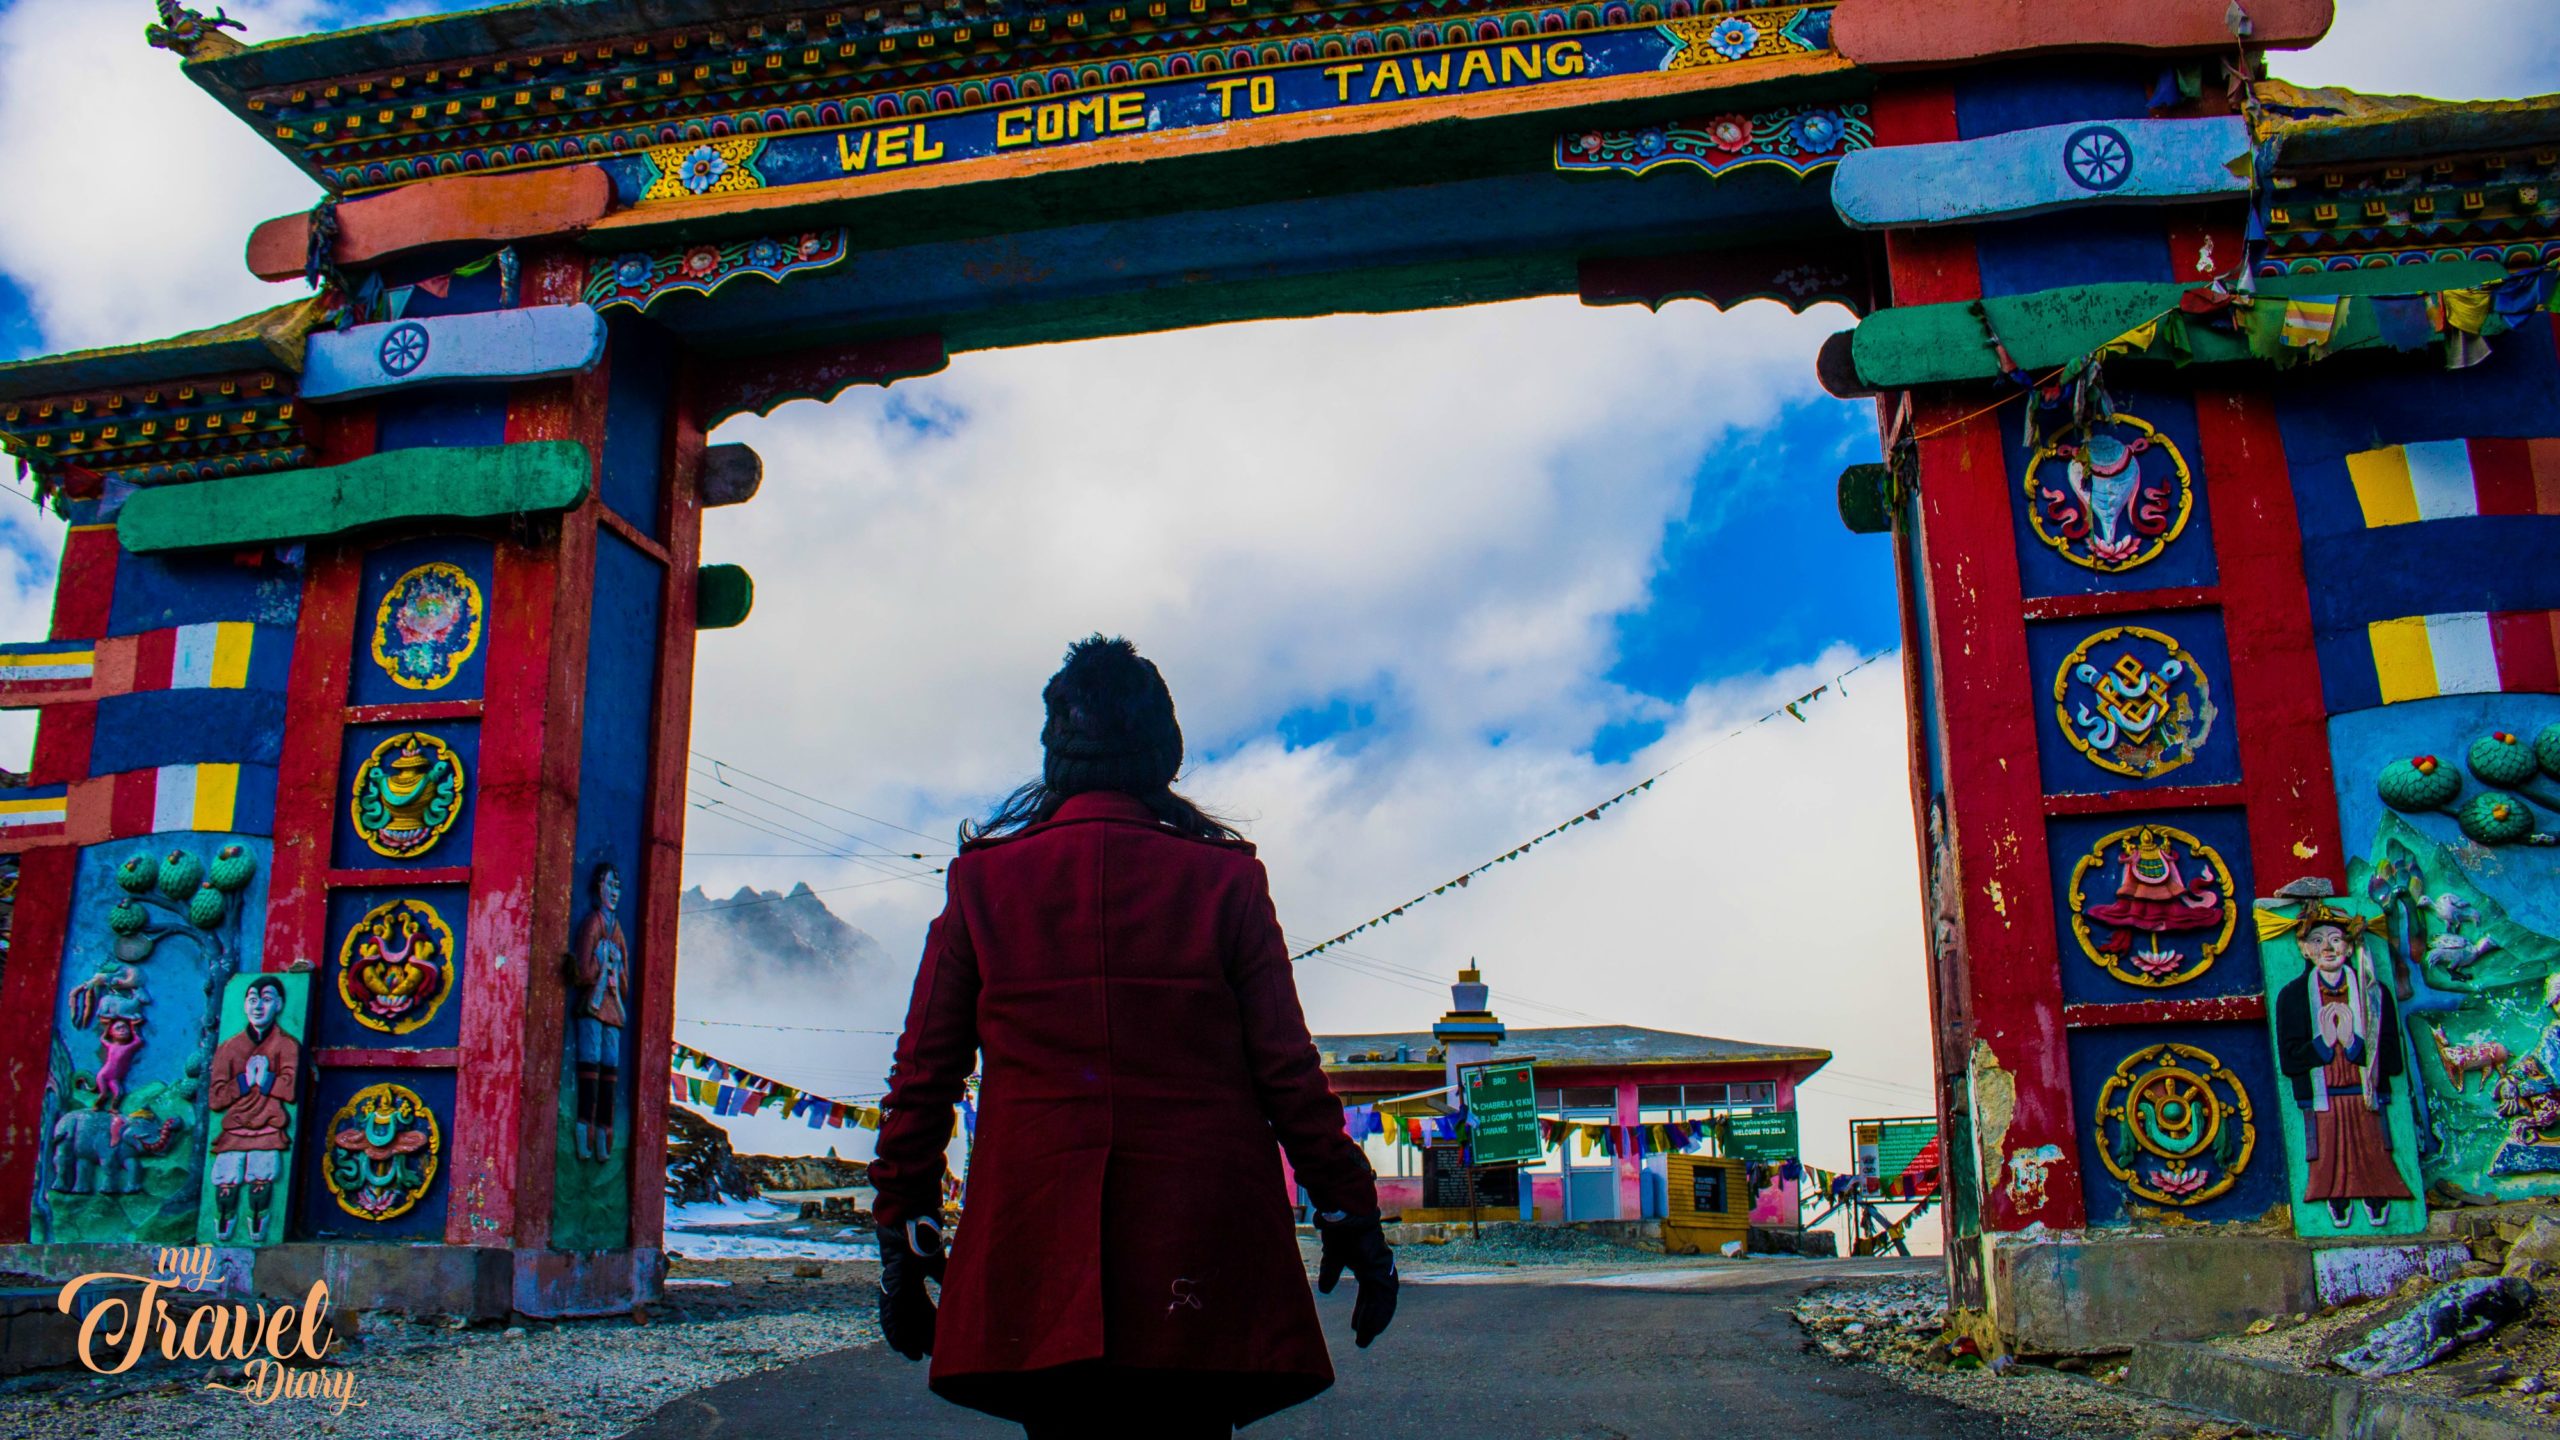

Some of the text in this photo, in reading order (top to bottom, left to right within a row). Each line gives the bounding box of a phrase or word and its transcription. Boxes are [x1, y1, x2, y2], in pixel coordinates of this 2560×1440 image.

[838, 40, 1584, 171] WEL COME TO TAWANG
[1522, 1098, 1532, 1106] KM
[1491, 1112, 1514, 1121] GOMPA
[1523, 1110, 1533, 1119] KM
[1482, 1123, 1534, 1136] TAWANG 77 KM
[1732, 1128, 1761, 1136] WELCOME
[1762, 1127, 1770, 1135] TO
